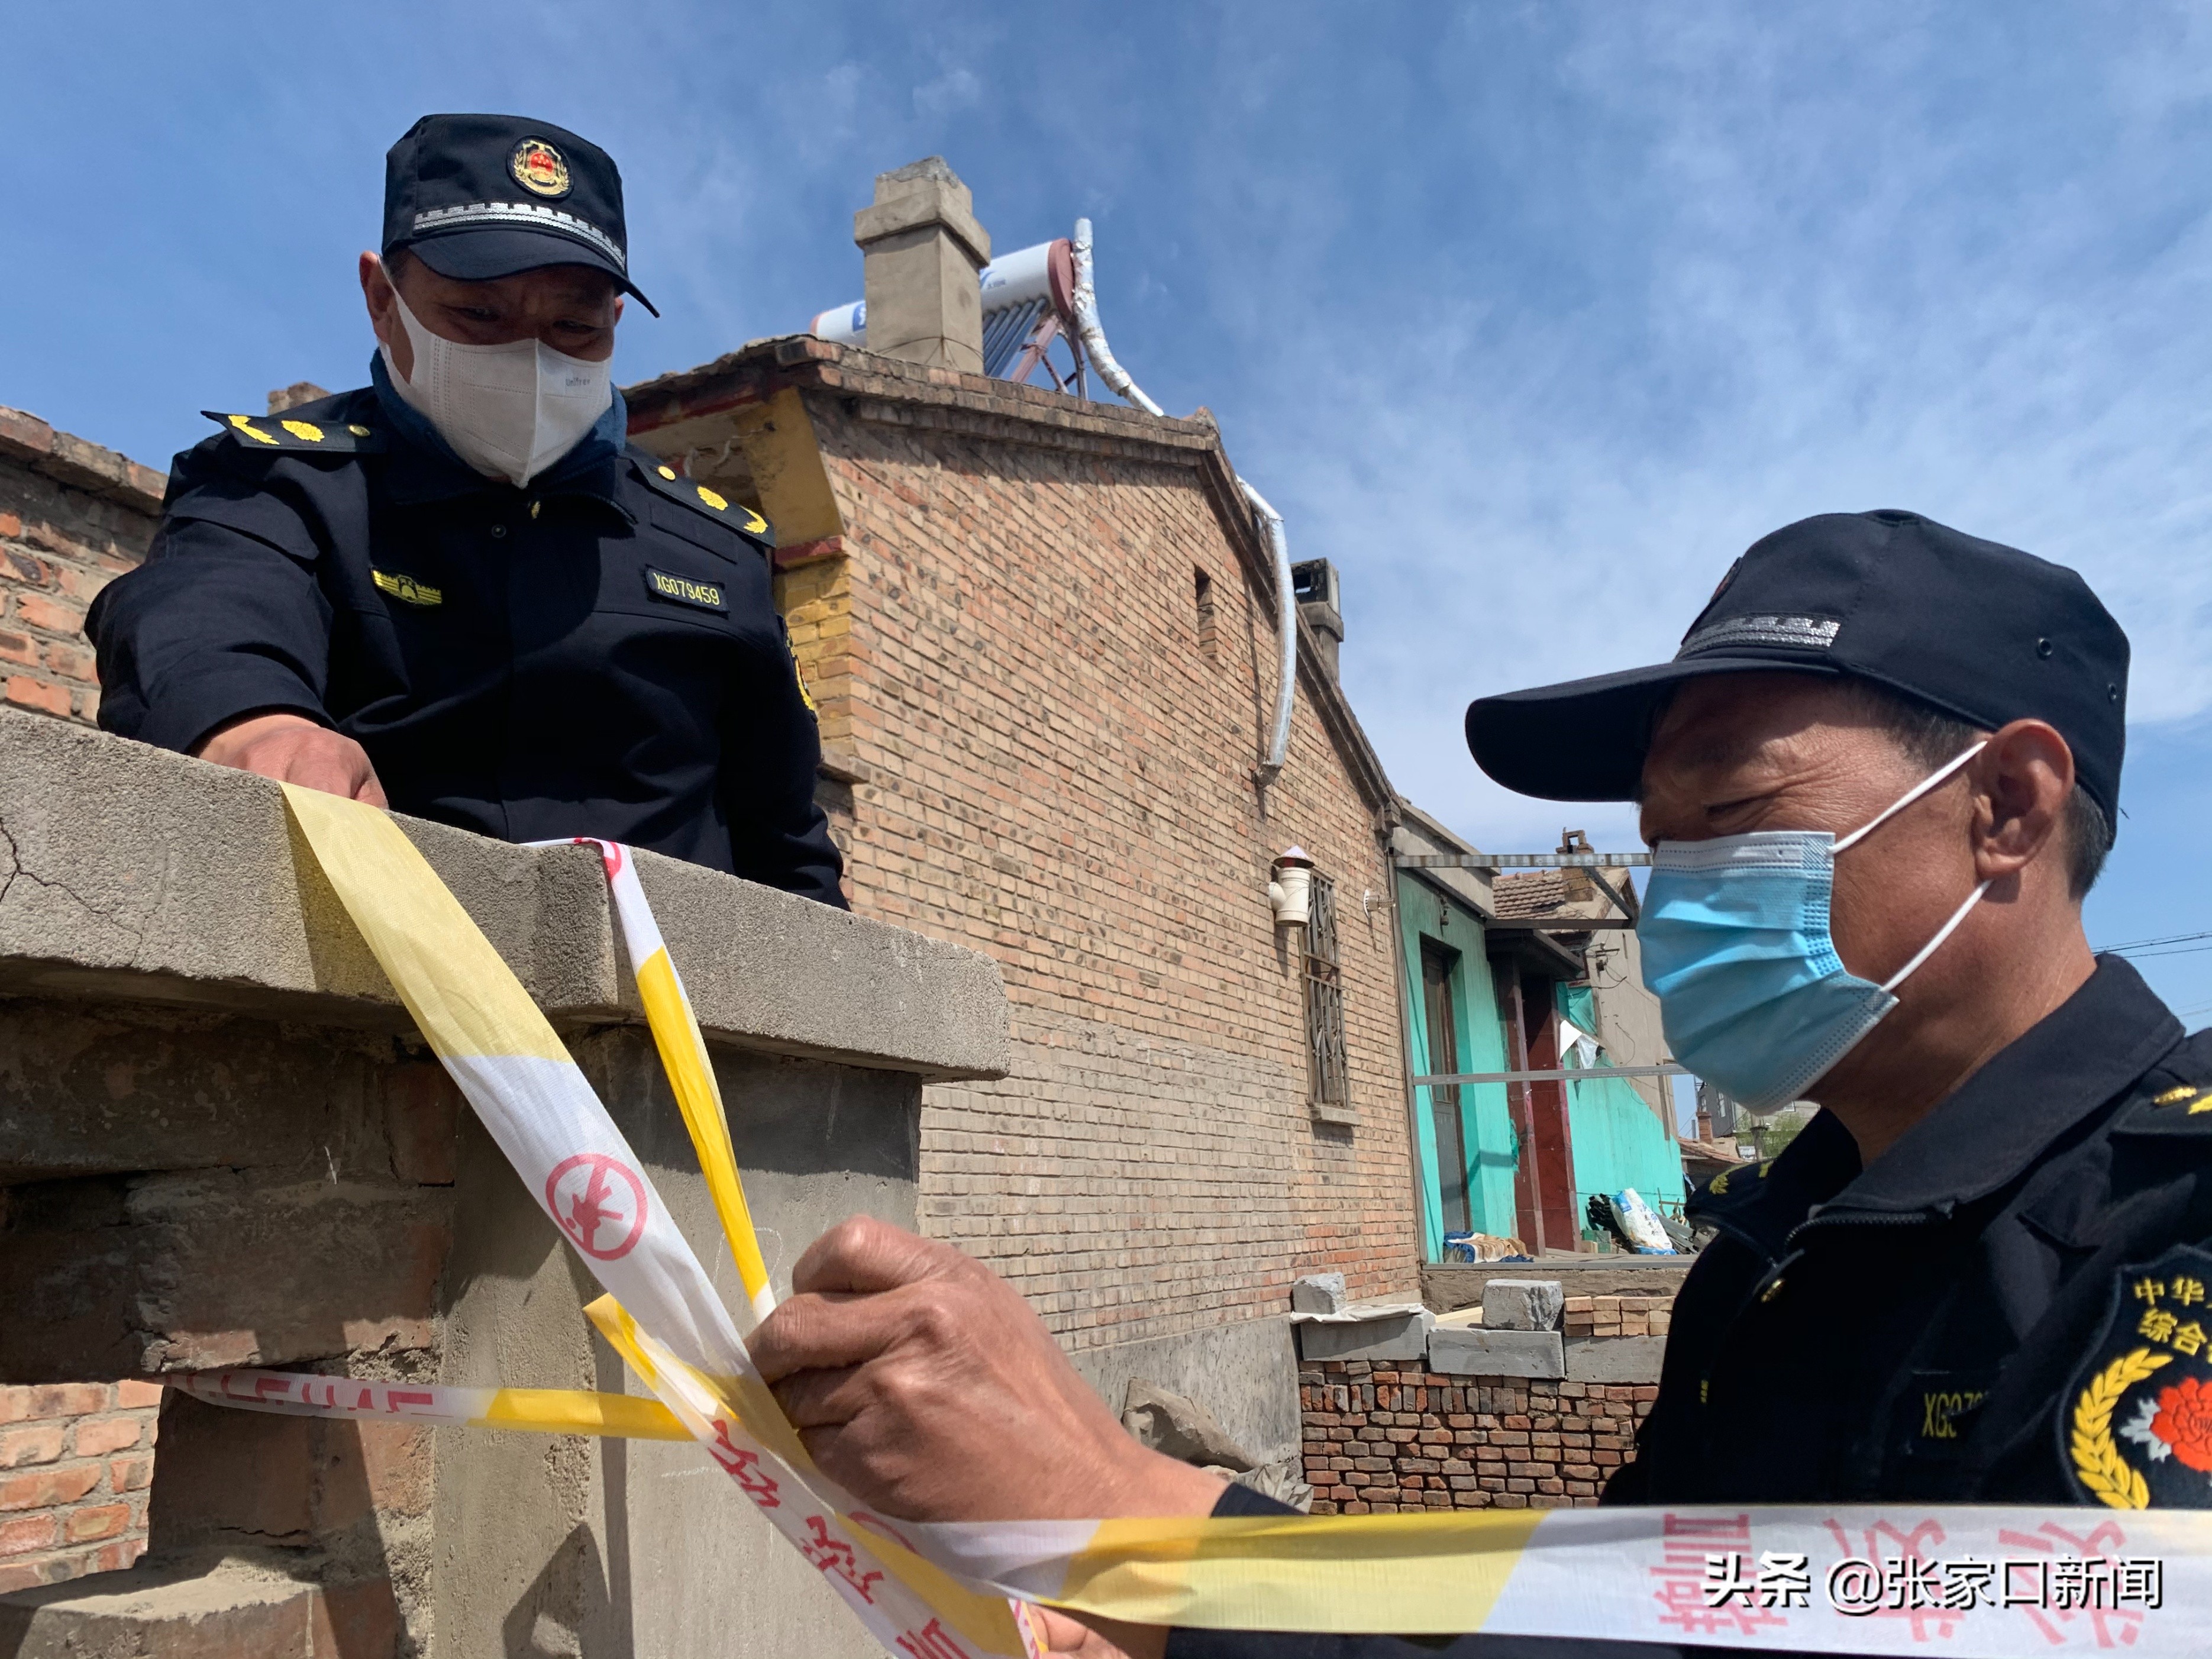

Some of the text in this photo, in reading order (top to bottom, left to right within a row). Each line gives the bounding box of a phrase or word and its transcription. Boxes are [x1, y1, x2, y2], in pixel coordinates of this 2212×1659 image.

[653, 572, 721, 606] XG079459
[2133, 1276, 2212, 1309] 中华
[2138, 1308, 2212, 1364] 综合
